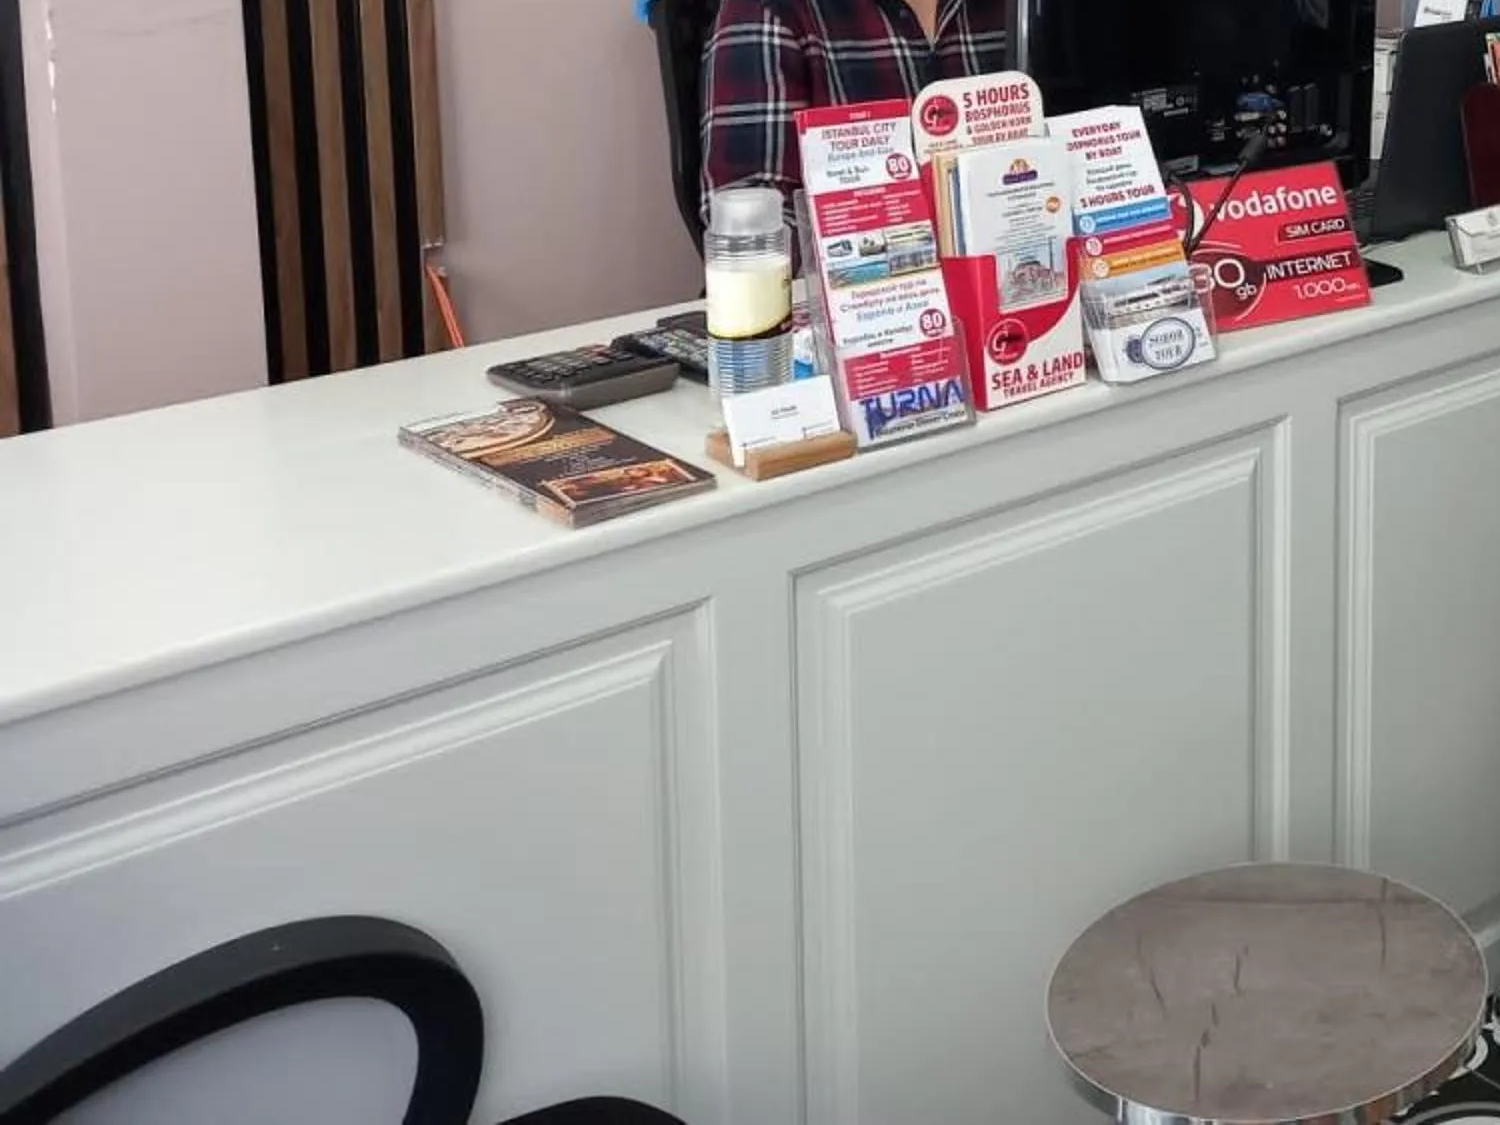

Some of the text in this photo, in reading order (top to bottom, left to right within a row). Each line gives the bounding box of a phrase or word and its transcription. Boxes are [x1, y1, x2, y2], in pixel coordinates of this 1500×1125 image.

[963, 83, 1030, 108] 5 HOURS
[965, 102, 1031, 123] BOSPHORUS
[822, 122, 896, 140] ISTANBUL CITY
[1072, 122, 1121, 137] EVERYDAY
[831, 135, 891, 152] TOUR DAILY
[1066, 130, 1141, 151] OSPHORUS TOUR
[887, 157, 910, 173] 80
[1090, 191, 1125, 206] HOURS
[1126, 184, 1155, 198] TOUR
[1210, 185, 1337, 222] vodafone
[1285, 219, 1345, 238] SIM CARD
[1266, 251, 1352, 280] INTERNET
[1236, 283, 1257, 300] gb
[921, 313, 943, 329] 80
[991, 352, 1083, 390] SEA & LAND
[1004, 373, 1074, 398] TRAVEL AGENCY
[860, 377, 965, 439] TURNA
